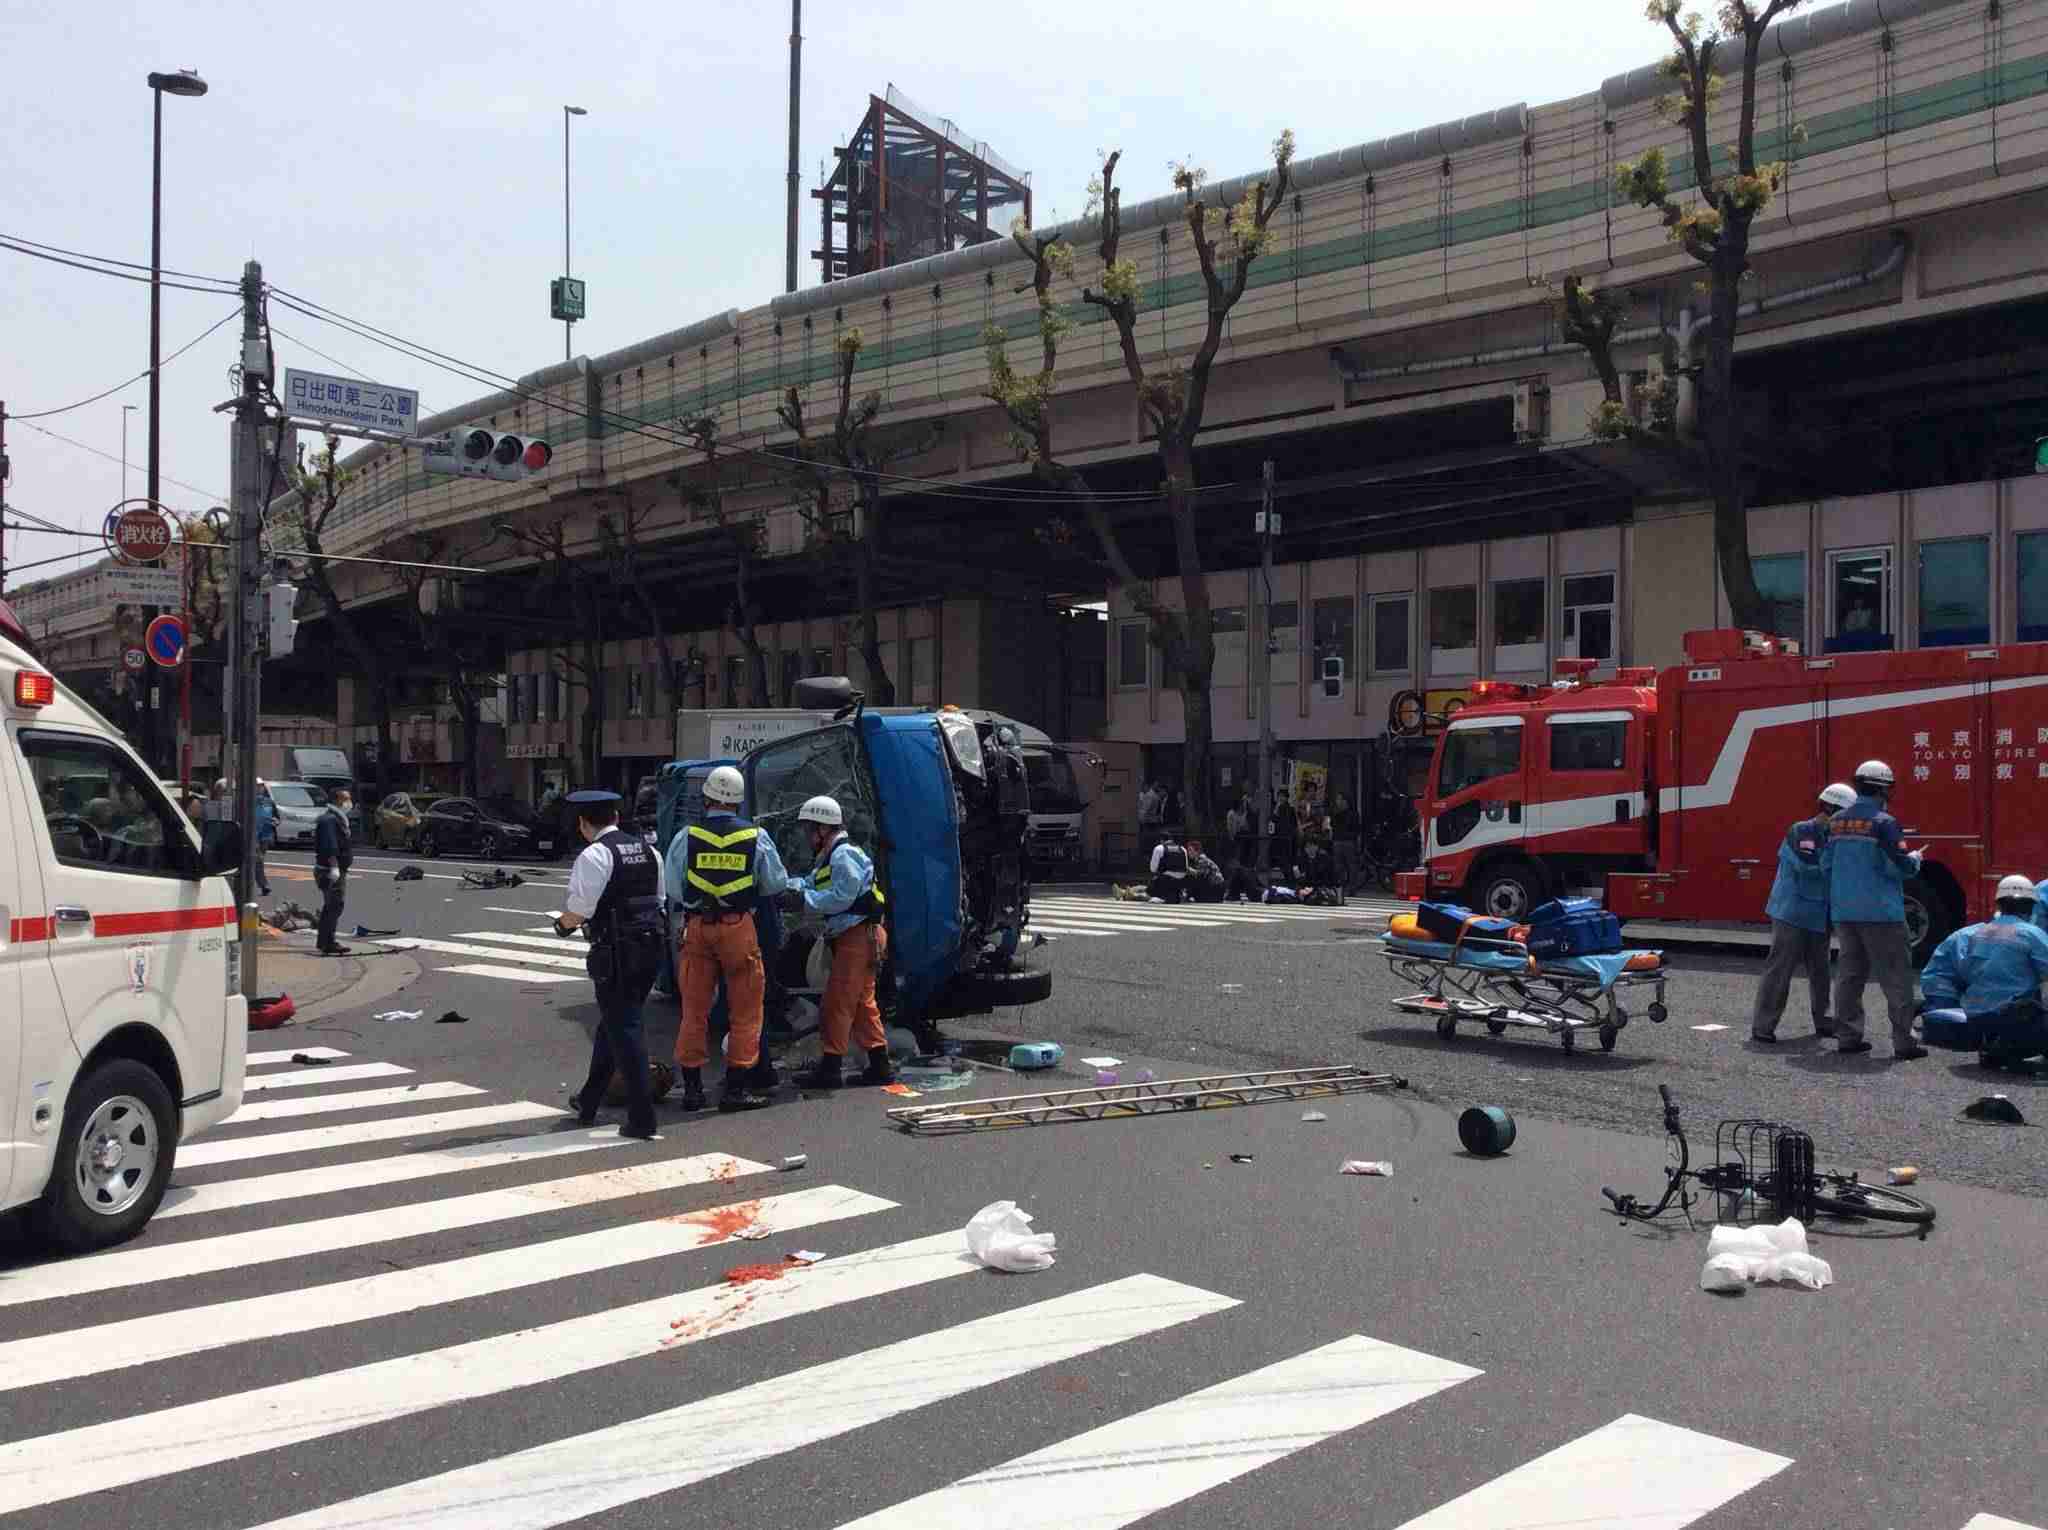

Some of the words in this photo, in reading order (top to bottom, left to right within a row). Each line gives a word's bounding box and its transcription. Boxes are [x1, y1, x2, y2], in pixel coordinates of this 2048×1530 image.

[292, 377, 412, 415] 日出町第二公園
[381, 413, 404, 426] Park
[120, 524, 167, 544] 消火栓
[127, 654, 145, 666] 50
[1913, 750, 1972, 760] TOKYO
[1994, 747, 2036, 759] FIRE
[622, 855, 649, 865] POLICE
